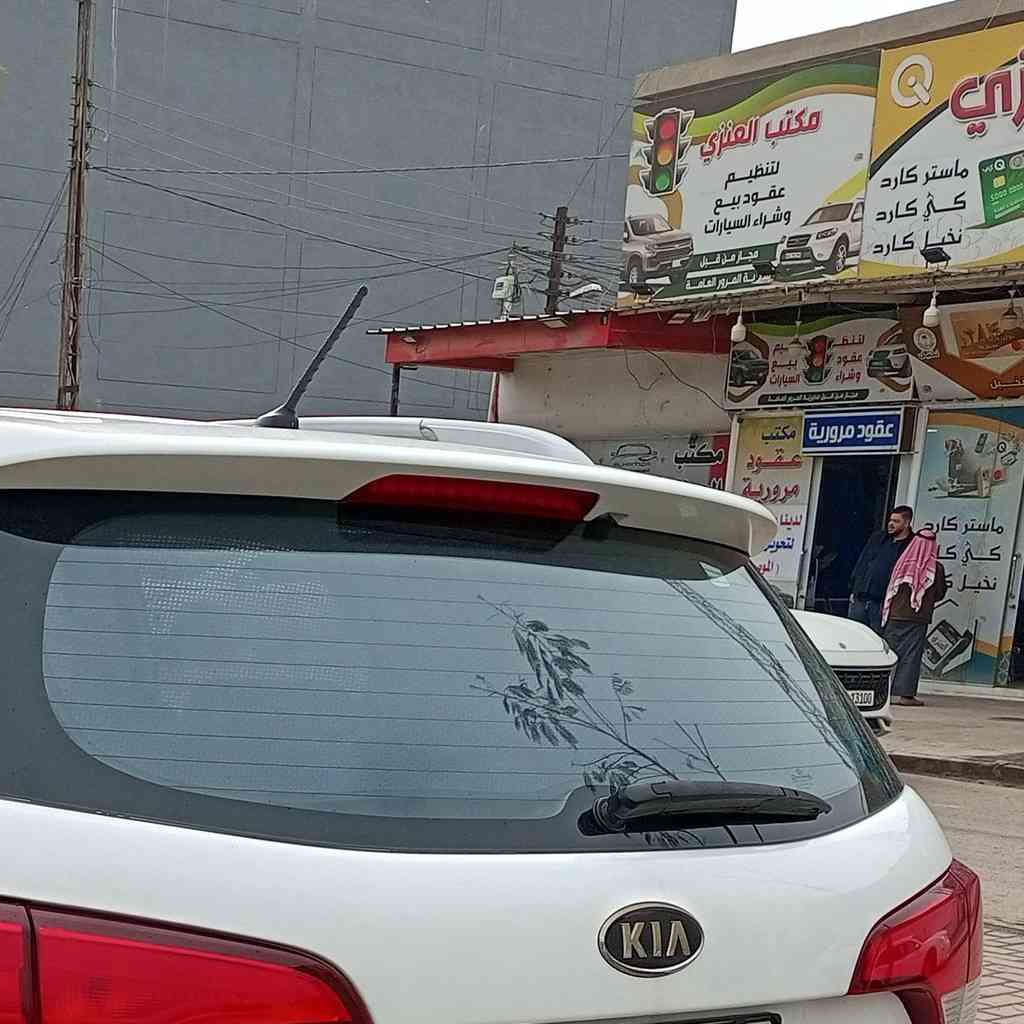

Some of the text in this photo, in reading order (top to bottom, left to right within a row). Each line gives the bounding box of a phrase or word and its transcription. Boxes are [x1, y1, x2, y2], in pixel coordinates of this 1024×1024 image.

[700, 107, 822, 163] مكتب العنزي
[724, 160, 780, 190] لتنظيم
[880, 159, 969, 190] ماستر كارد
[713, 185, 785, 215] عقود بيع
[875, 198, 918, 223] كارد
[704, 205, 792, 236] وشراء السيارات
[873, 232, 914, 256] كارد
[722, 253, 736, 265] من
[685, 277, 717, 290] العامة
[717, 273, 742, 290] المرور
[761, 424, 796, 445] مكتب
[808, 420, 895, 444] عقود مرورية
[674, 443, 724, 470] مكتب
[746, 448, 802, 473] عقود
[742, 477, 801, 504] مرورية
[780, 513, 803, 530] لدينا
[962, 517, 1004, 535] ماستر
[937, 545, 956, 560] كا
[957, 574, 997, 593] نخيل
[620, 920, 691, 959] KIA
